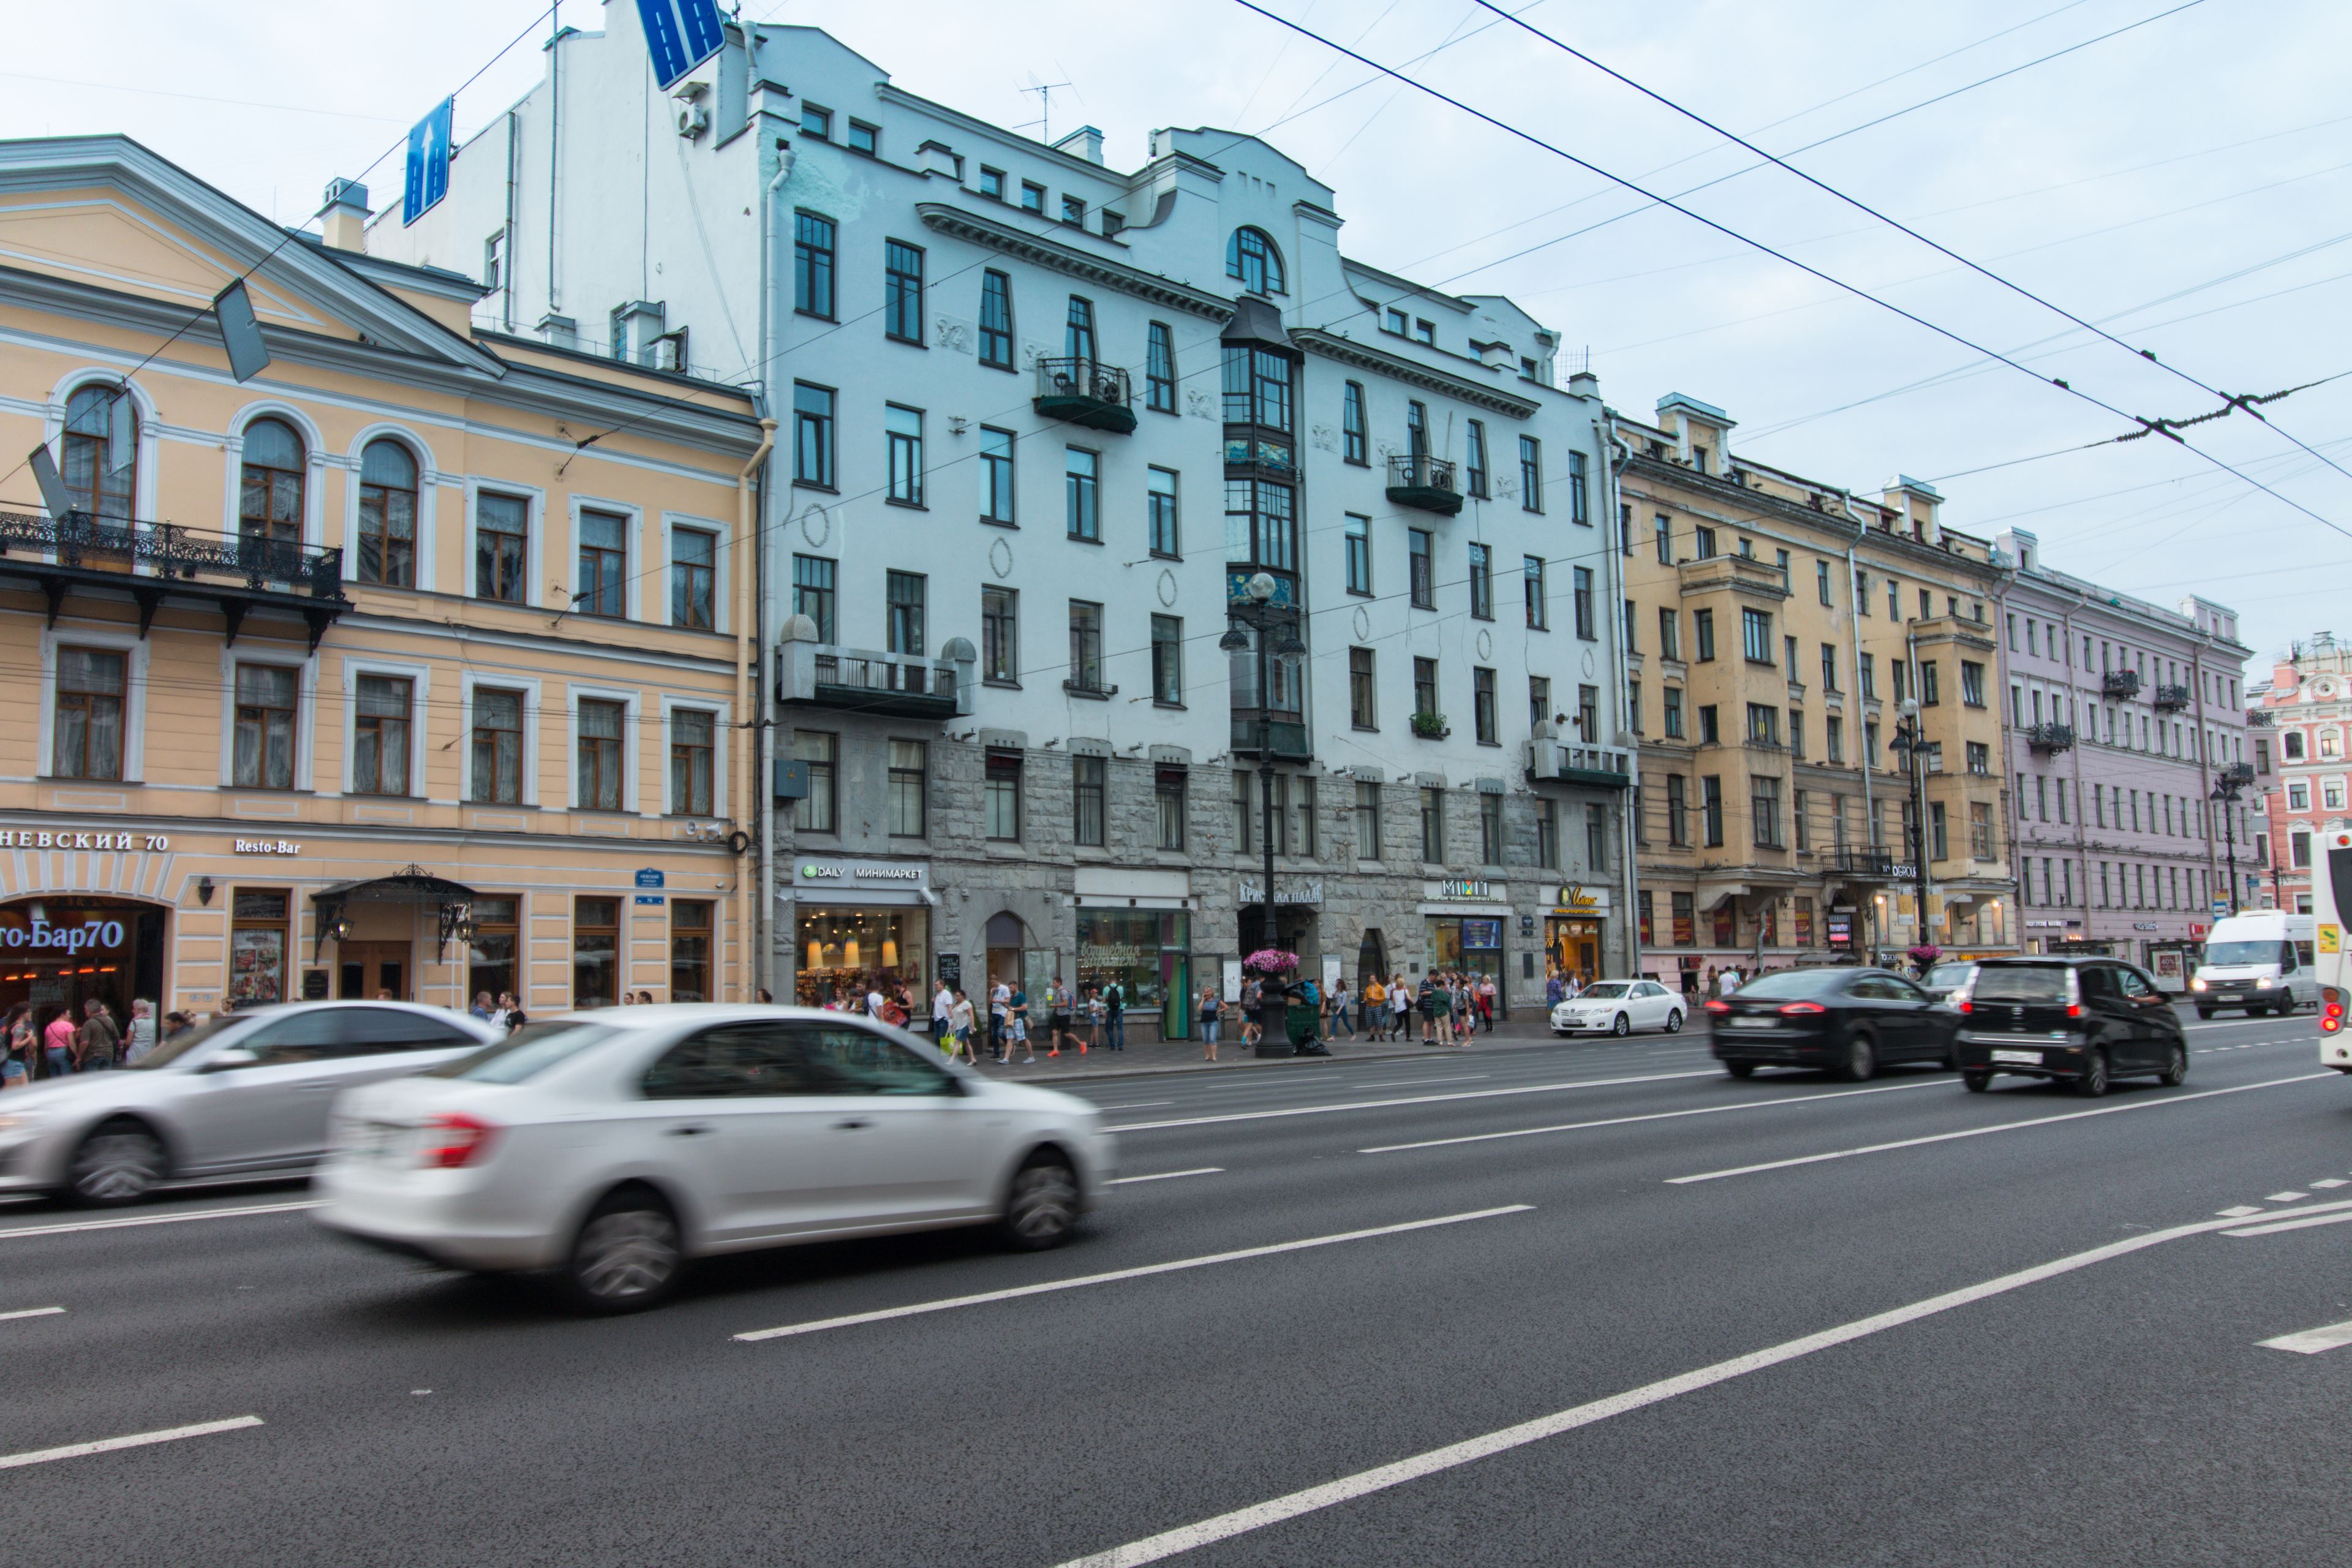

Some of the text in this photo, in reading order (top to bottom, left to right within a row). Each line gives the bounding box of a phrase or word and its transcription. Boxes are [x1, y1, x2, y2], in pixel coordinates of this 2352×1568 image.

[0, 831, 168, 851] НЕВСКИЙ 70
[235, 839, 301, 854] Resto-Bar
[818, 867, 922, 879] DAILY МИНИМАРКЕТ
[1238, 882, 1322, 902] КРИСЛЛ ПАЛАС
